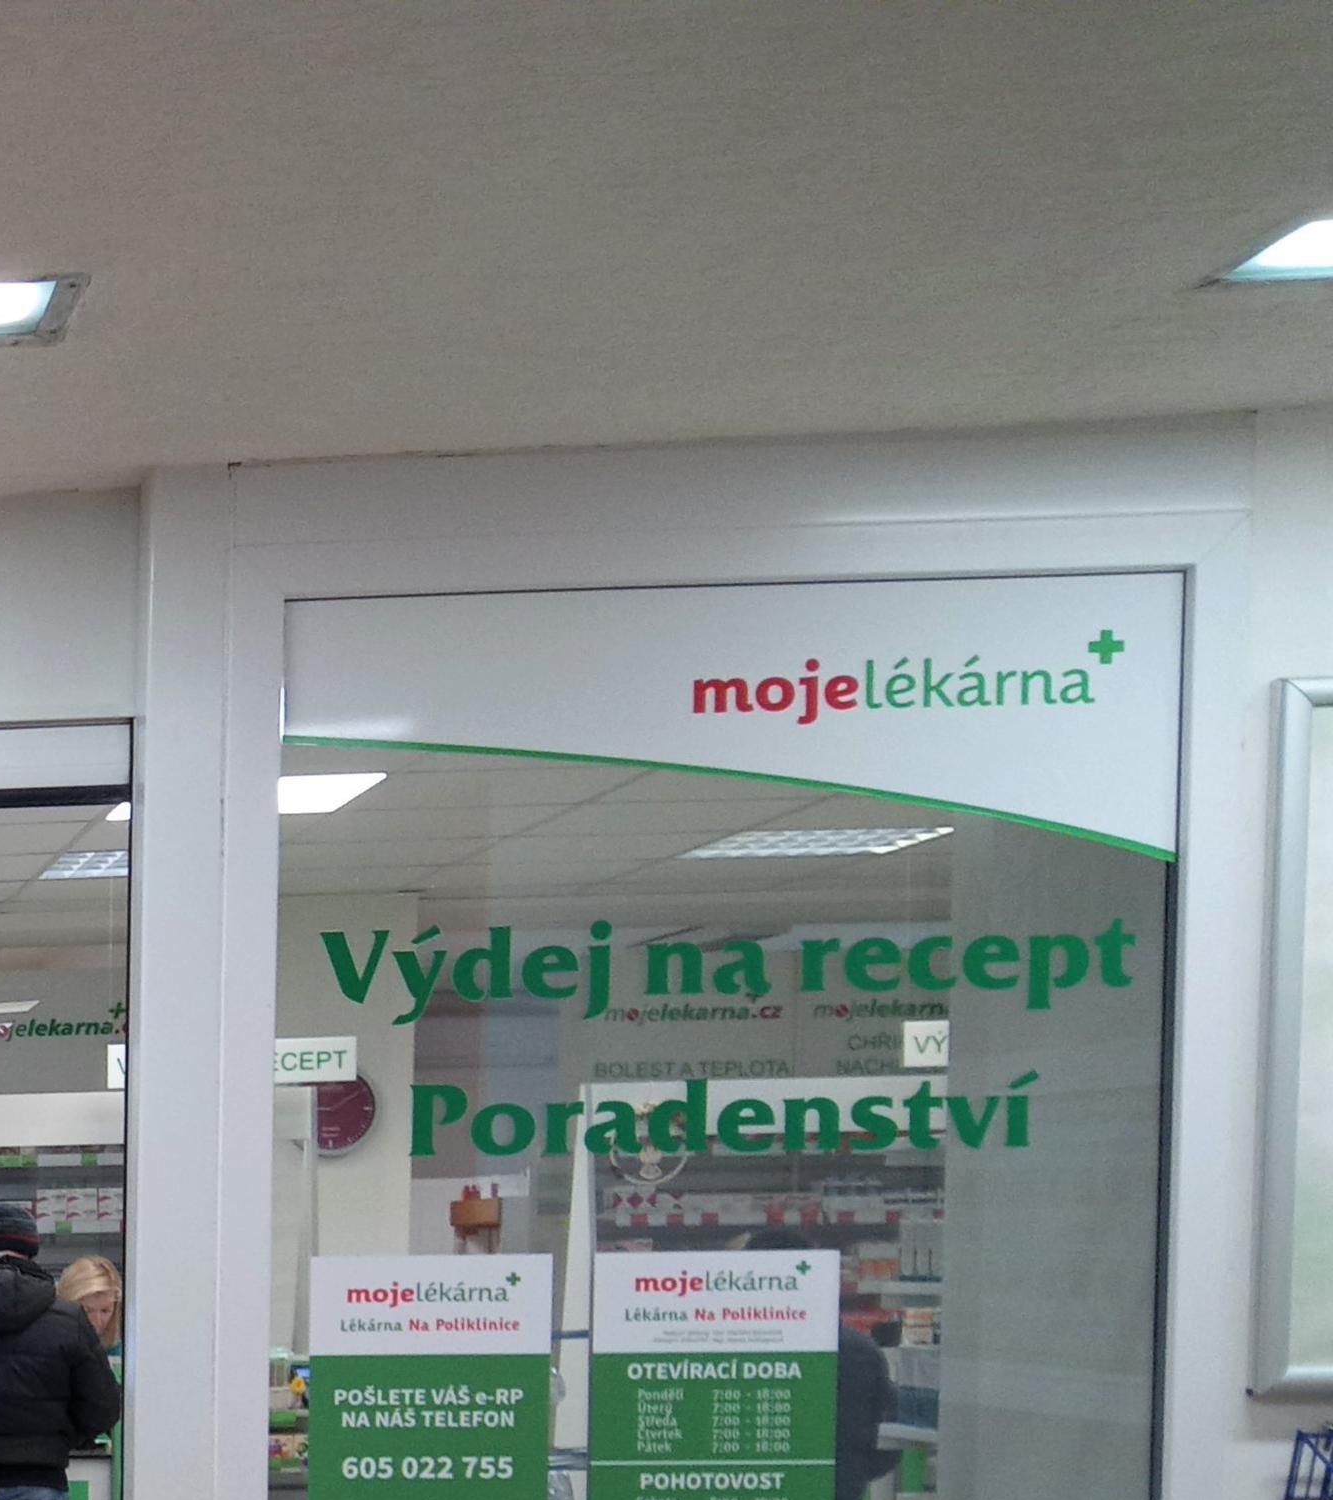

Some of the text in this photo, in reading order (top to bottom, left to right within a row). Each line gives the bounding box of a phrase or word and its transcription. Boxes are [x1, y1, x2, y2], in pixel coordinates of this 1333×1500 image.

[692, 656, 1095, 724] mojelékárna
[320, 917, 1136, 1025] Výdej na recept
[408, 1069, 1039, 1157] Poradenství
[346, 1281, 509, 1308] mojelékárna
[634, 1270, 799, 1297] mojelékárna
[340, 1317, 520, 1332] Lékárna Na Poliklinice
[625, 1306, 807, 1322] Lékárna Na Poliklinice
[627, 1359, 802, 1380] OTEVÍRACÍ DOBA
[334, 1384, 524, 1406] POŠLETE VÁŠ e-RP
[341, 1407, 515, 1428] NA NÁŠ TELEFON
[341, 1457, 514, 1479] 605 022 755
[640, 1472, 785, 1490] POHOTOVOST
